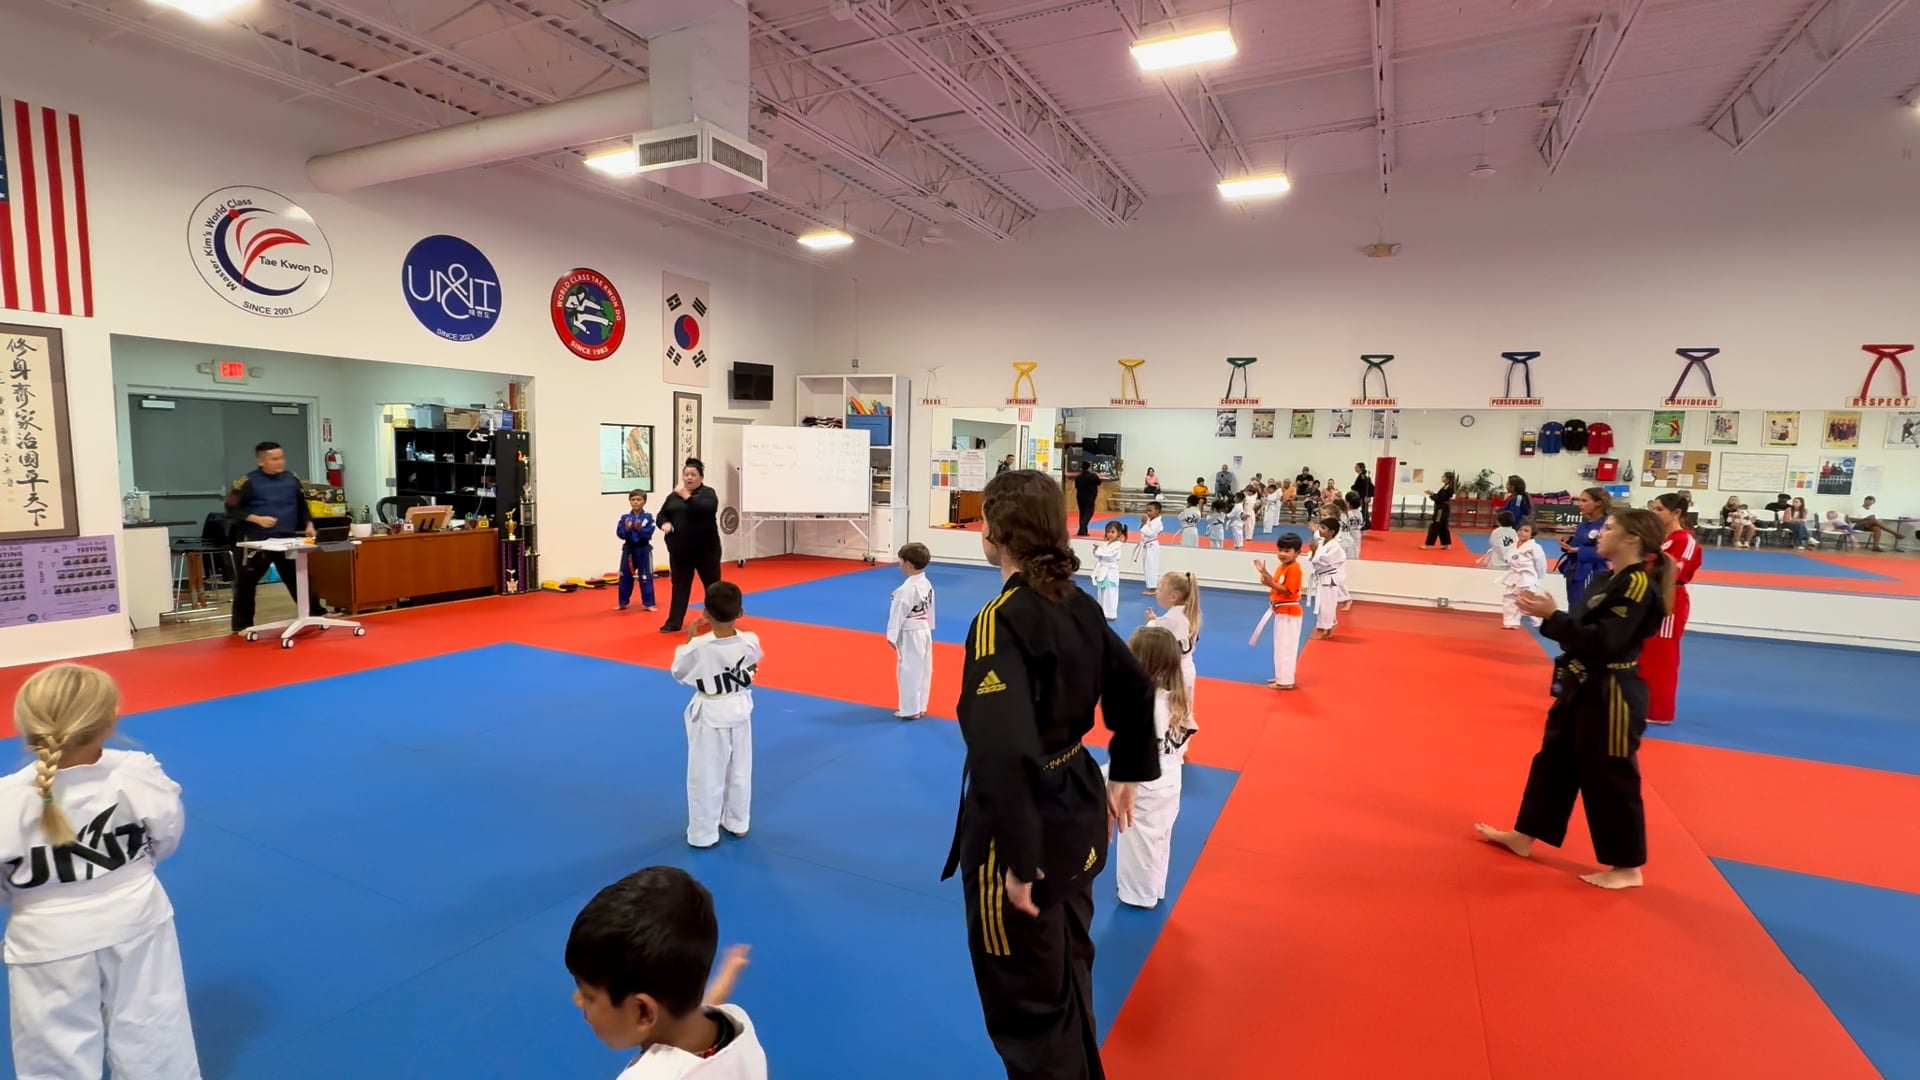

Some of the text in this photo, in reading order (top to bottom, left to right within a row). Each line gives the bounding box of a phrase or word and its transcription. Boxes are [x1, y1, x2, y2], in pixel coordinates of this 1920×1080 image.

[204, 199, 252, 291] Master Kim's World Class
[259, 255, 328, 275] Tae Kwon Do
[557, 274, 622, 321] WORLD CLASS TAE KWON DO
[242, 301, 293, 315] SINCE 2001
[436, 328, 474, 341] SINCE 2021
[570, 340, 591, 355] SINCE
[221, 362, 243, 378] EXIT
[1352, 398, 1396, 406] SELF CONTROL
[1491, 398, 1542, 406] PERSEVERANCE
[1664, 398, 1718, 406] CONFIDENCE
[1852, 398, 1910, 406] RESPECT
